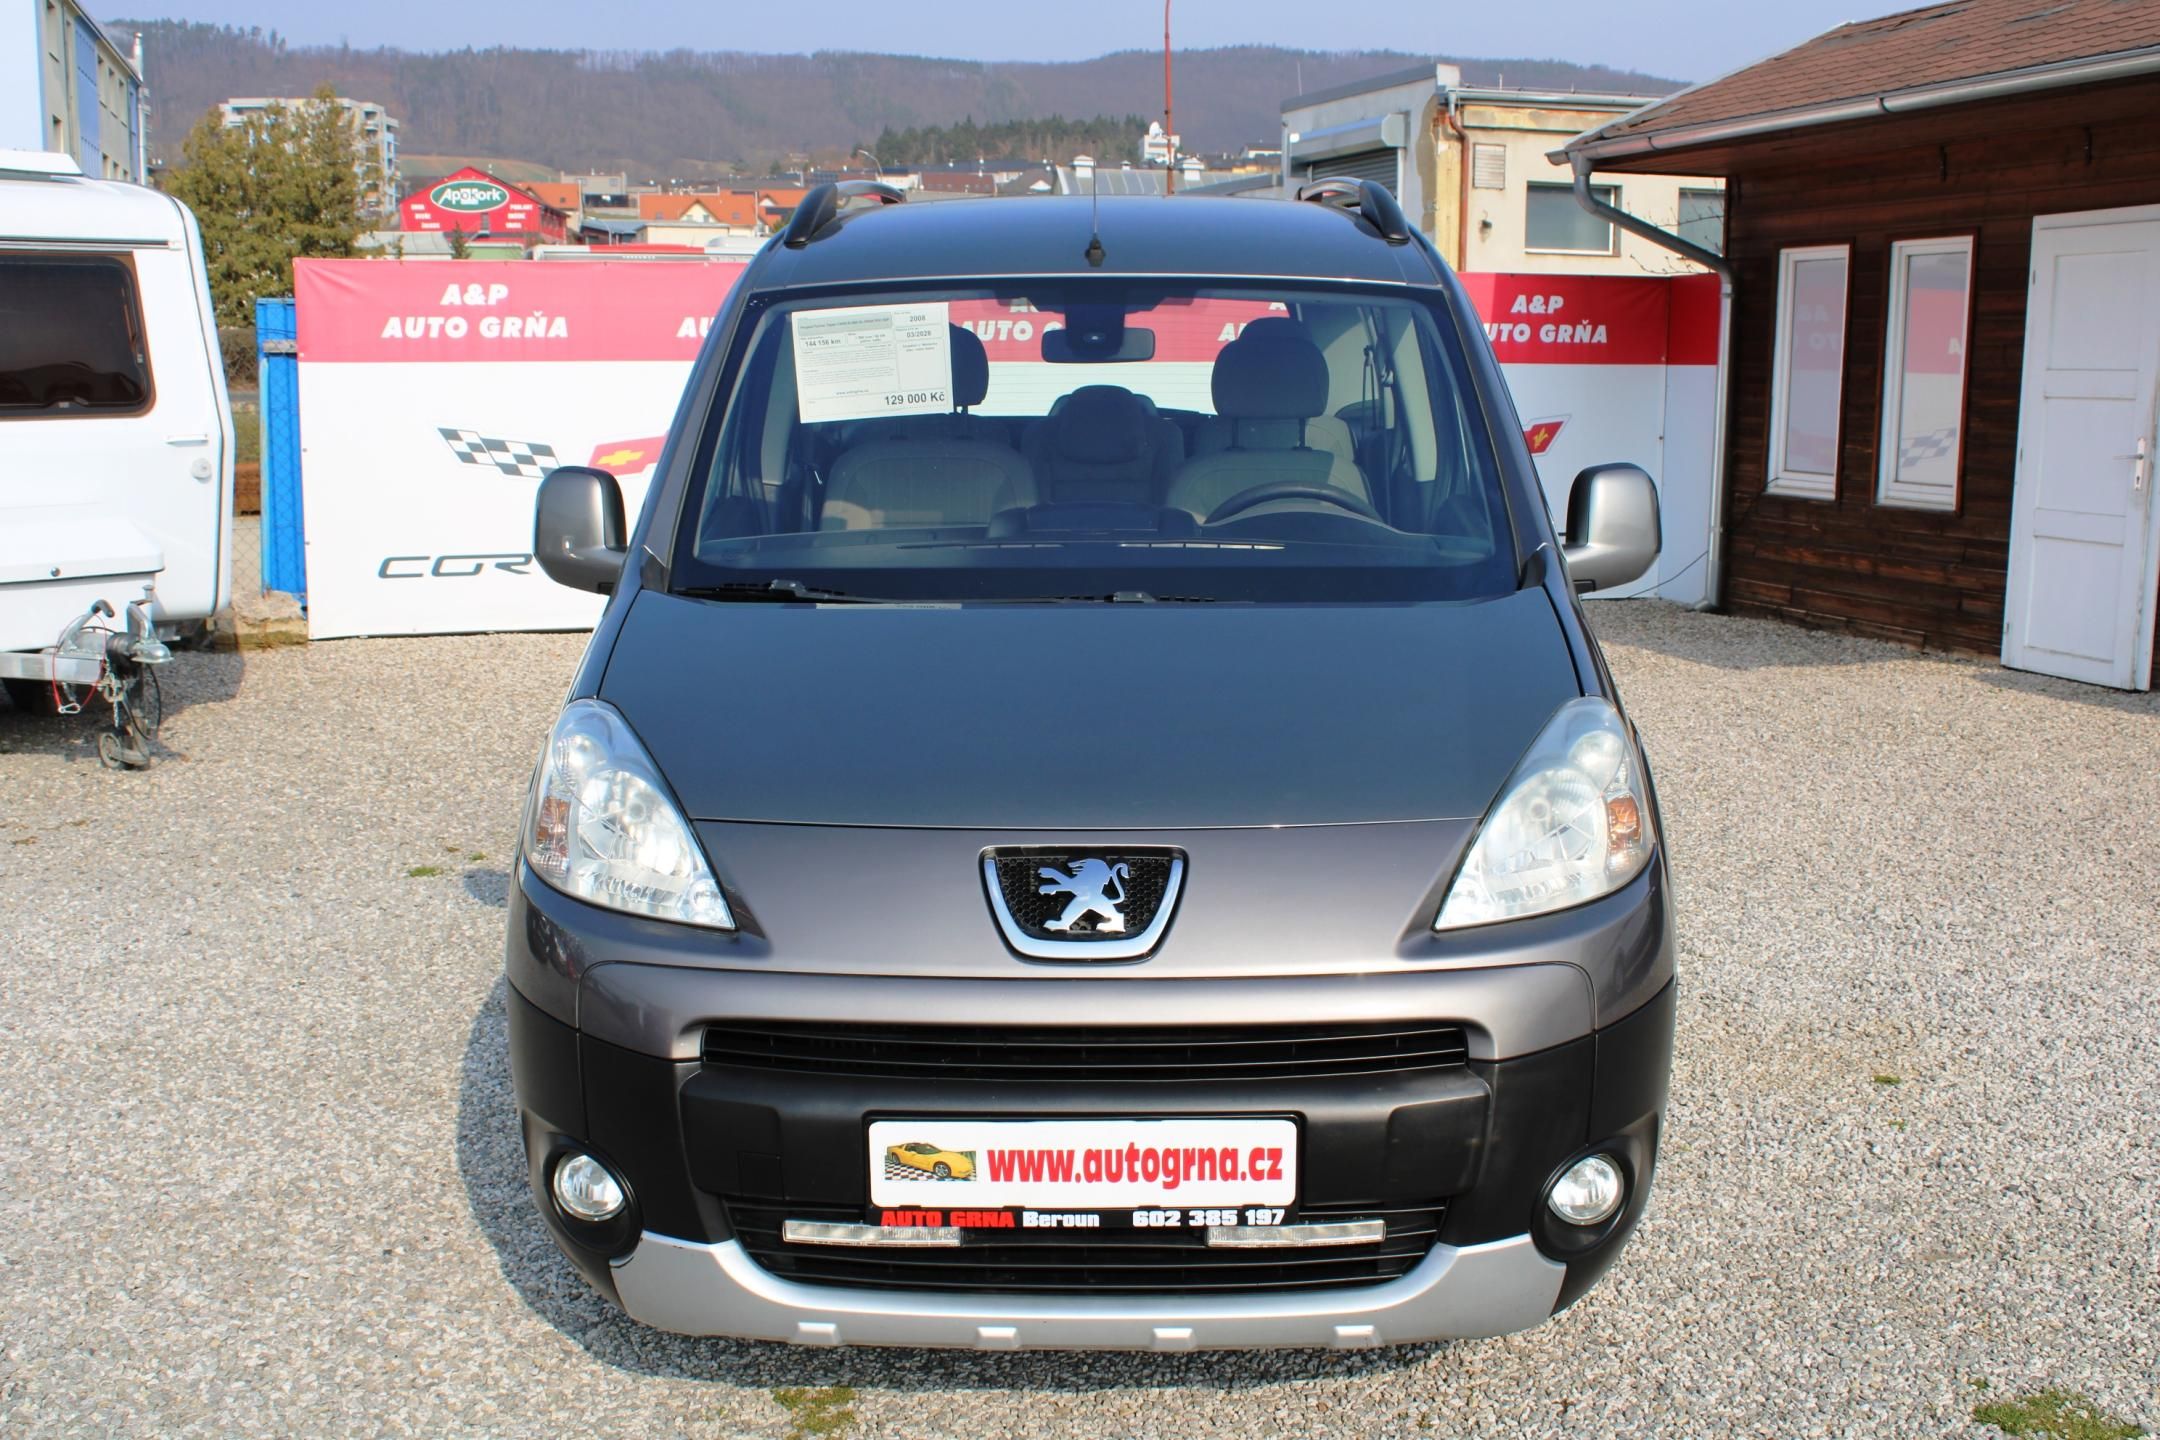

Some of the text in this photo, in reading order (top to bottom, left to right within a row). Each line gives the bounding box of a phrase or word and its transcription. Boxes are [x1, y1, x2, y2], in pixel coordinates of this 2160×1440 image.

[440, 284, 509, 306] A&P
[1510, 294, 1564, 314] A&P
[380, 311, 569, 339] AUTO GRŇA
[676, 317, 715, 338] AU
[1484, 319, 1608, 344] UTO GRŇA
[885, 391, 945, 406] 129 000 Kč
[987, 1142, 1283, 1189] www.autogrna.cz
[881, 1211, 943, 1228] AUTO
[1022, 1211, 1100, 1228] Beroun
[1132, 1210, 1182, 1227] 602
[1188, 1210, 1239, 1227] 385
[1244, 1209, 1285, 1226] 197
